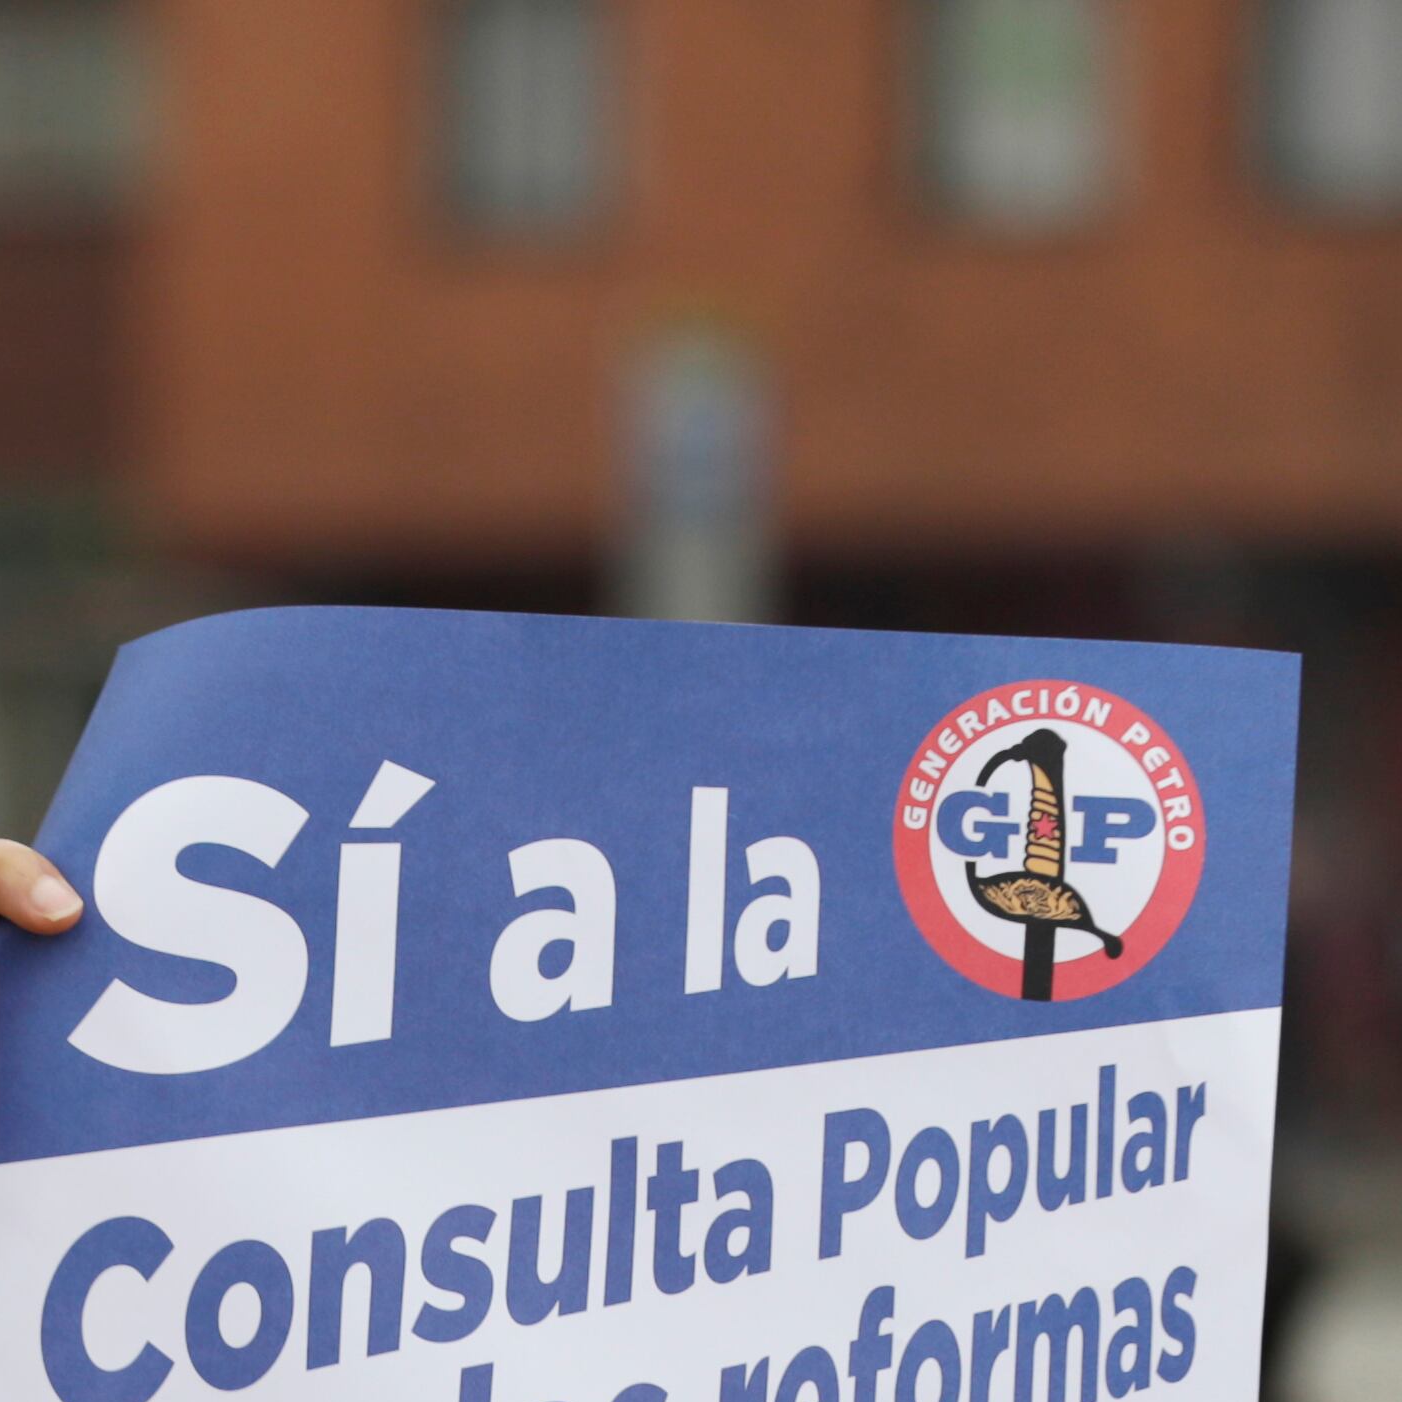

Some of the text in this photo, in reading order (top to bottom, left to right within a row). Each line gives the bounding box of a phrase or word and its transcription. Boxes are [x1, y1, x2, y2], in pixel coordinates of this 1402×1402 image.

[903, 686, 1195, 851] GENERACIÓN PETRO
[66, 758, 822, 1076] Sí a la
[817, 1064, 1208, 1259] Popular
